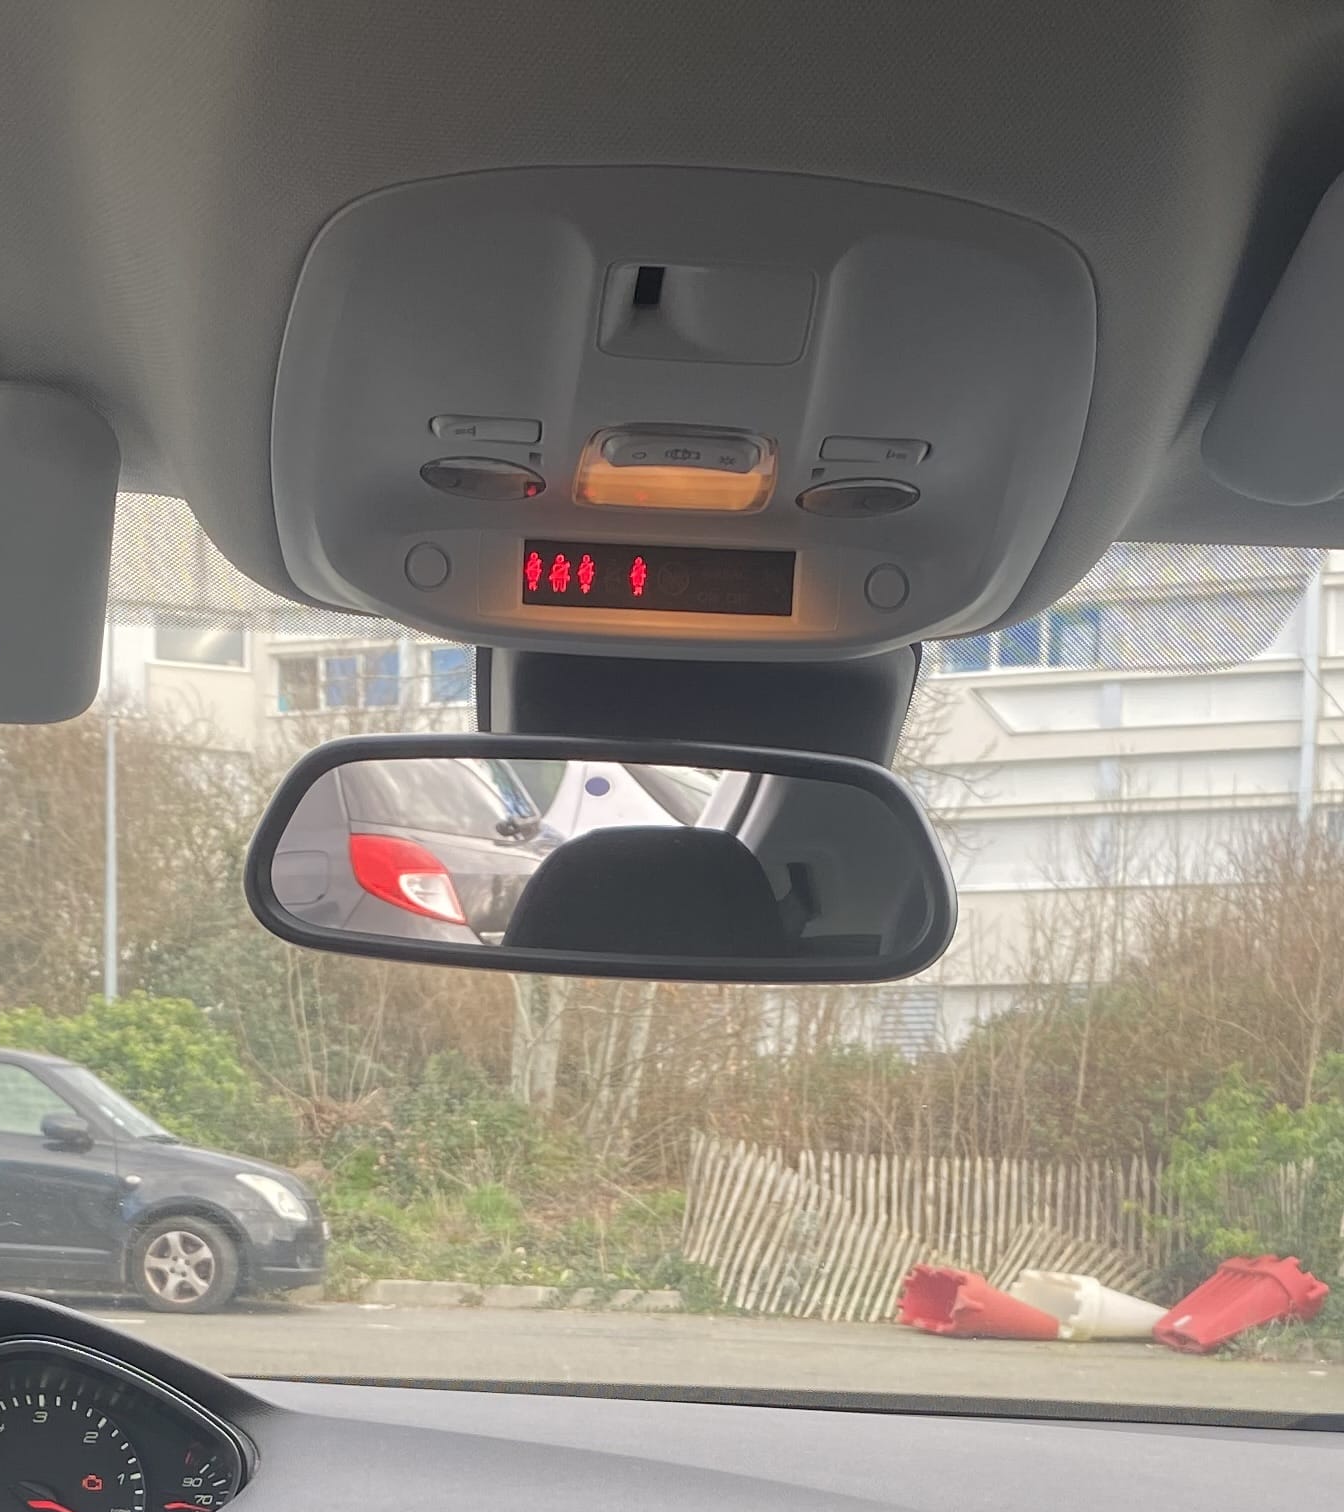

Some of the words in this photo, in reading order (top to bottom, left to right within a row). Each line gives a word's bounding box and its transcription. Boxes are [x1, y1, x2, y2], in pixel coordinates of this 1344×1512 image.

[32, 1410, 49, 1424] 3
[83, 1430, 99, 1444] 2
[117, 1473, 125, 1486] 1
[181, 1477, 203, 1488] 90
[194, 1494, 214, 1506] 70
